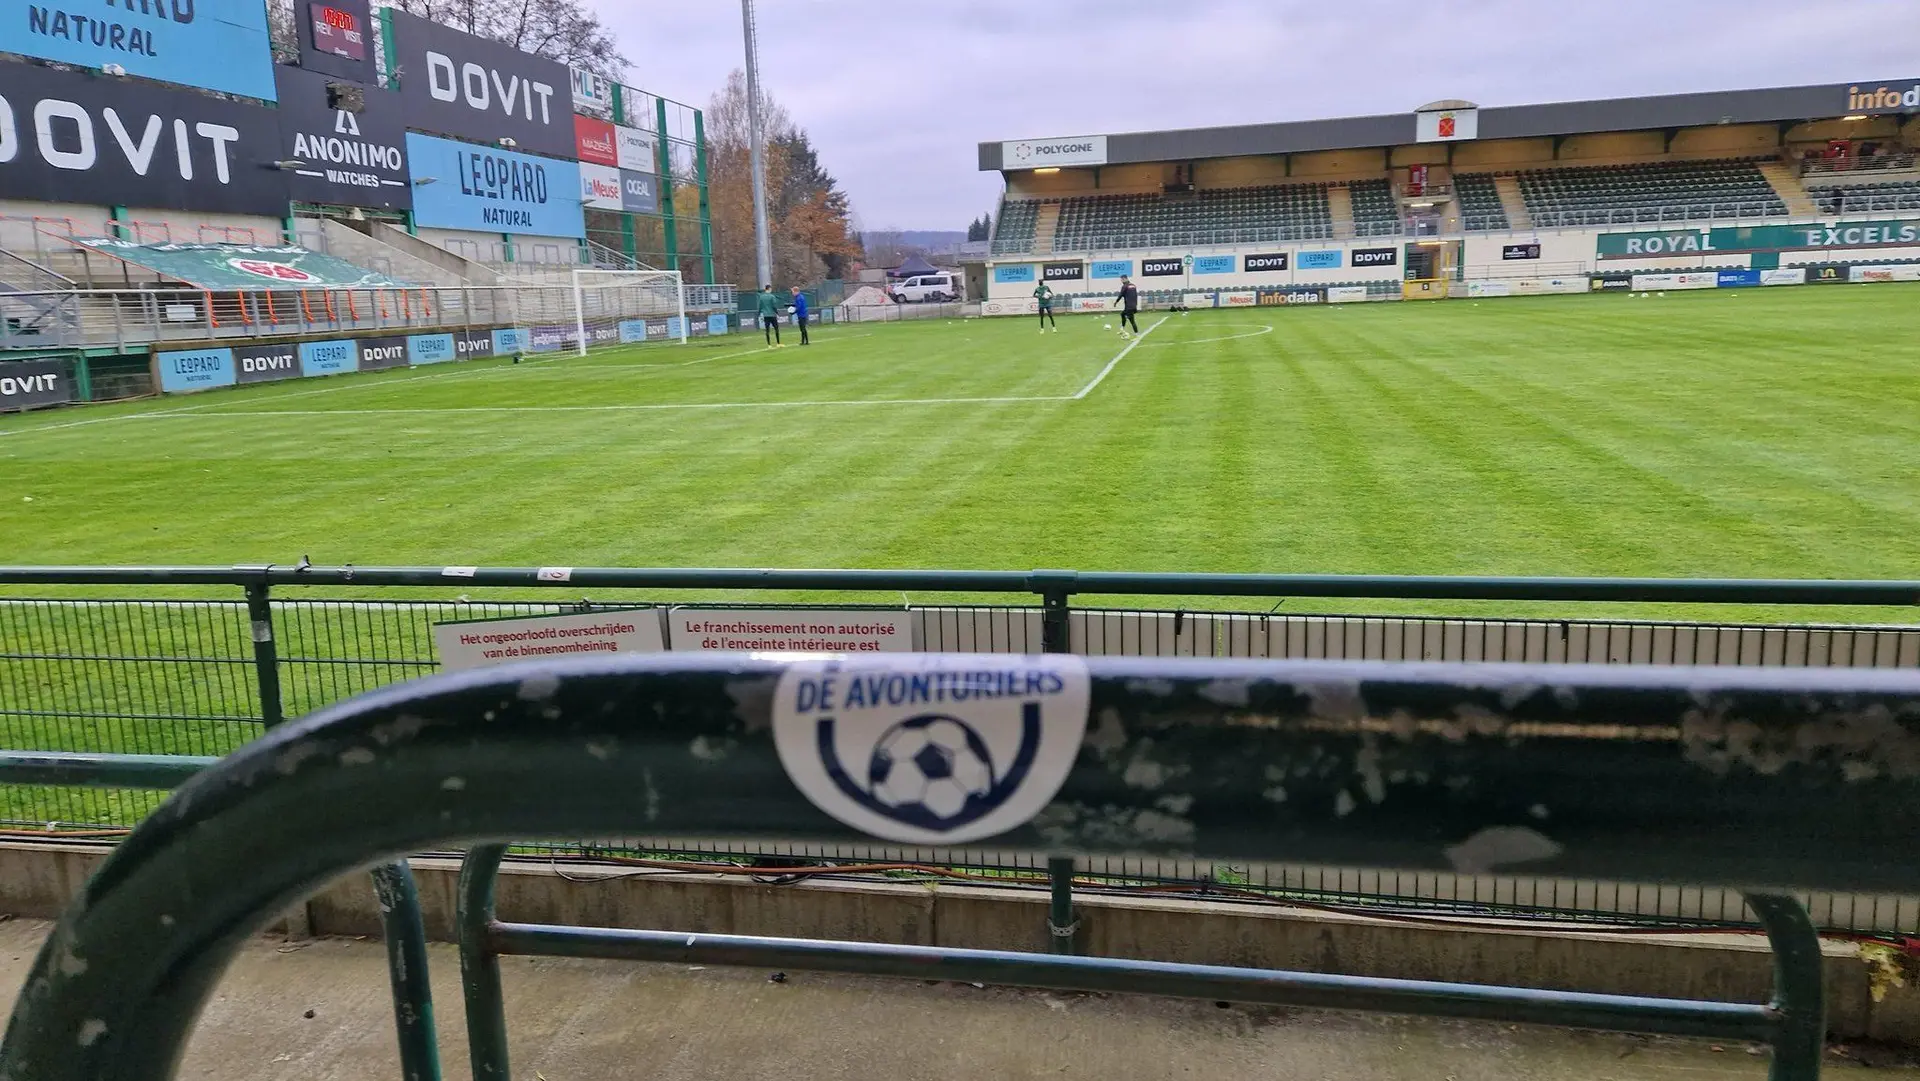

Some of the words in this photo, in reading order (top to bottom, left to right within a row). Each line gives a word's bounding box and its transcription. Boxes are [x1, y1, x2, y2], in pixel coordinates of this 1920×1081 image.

[29, 4, 157, 57] NATURAL
[426, 51, 553, 125] DOVIT
[1849, 84, 1920, 110] infod
[0, 94, 239, 185] OVIT
[1035, 143, 1092, 155] POLYGONE
[293, 132, 402, 171] ANONIMO
[326, 169, 379, 188] WATCHES
[457, 150, 548, 204] LEOPARD
[483, 207, 533, 228] NATURAL
[1627, 233, 1716, 254] ROYAL
[1807, 224, 1920, 247] EXCELS
[1248, 258, 1285, 267] DOVIT
[1355, 252, 1394, 262] DOVIT
[1046, 267, 1080, 276] DOVIT
[1145, 263, 1180, 272] DOVIT
[312, 346, 348, 362] LEOPARD
[363, 346, 404, 361] DOVIT
[174, 356, 221, 375] LEOPARD
[242, 355, 294, 372] DOVIT
[0, 373, 57, 396] OVIT
[460, 634, 481, 646] Het
[483, 628, 557, 646] ongeoorloofd
[558, 622, 635, 640] overschrijden
[685, 620, 701, 634] Le
[703, 620, 807, 635] franchissement
[809, 623, 836, 635] non
[838, 621, 896, 636] autorisé
[483, 648, 504, 660] van
[505, 645, 519, 658] de
[520, 640, 618, 656] binnenomheining
[701, 637, 718, 649] de
[720, 635, 786, 650] l'enceinte
[788, 637, 857, 651] intérieure
[858, 640, 881, 651] est
[842, 667, 1065, 712] AVONTURIERS
